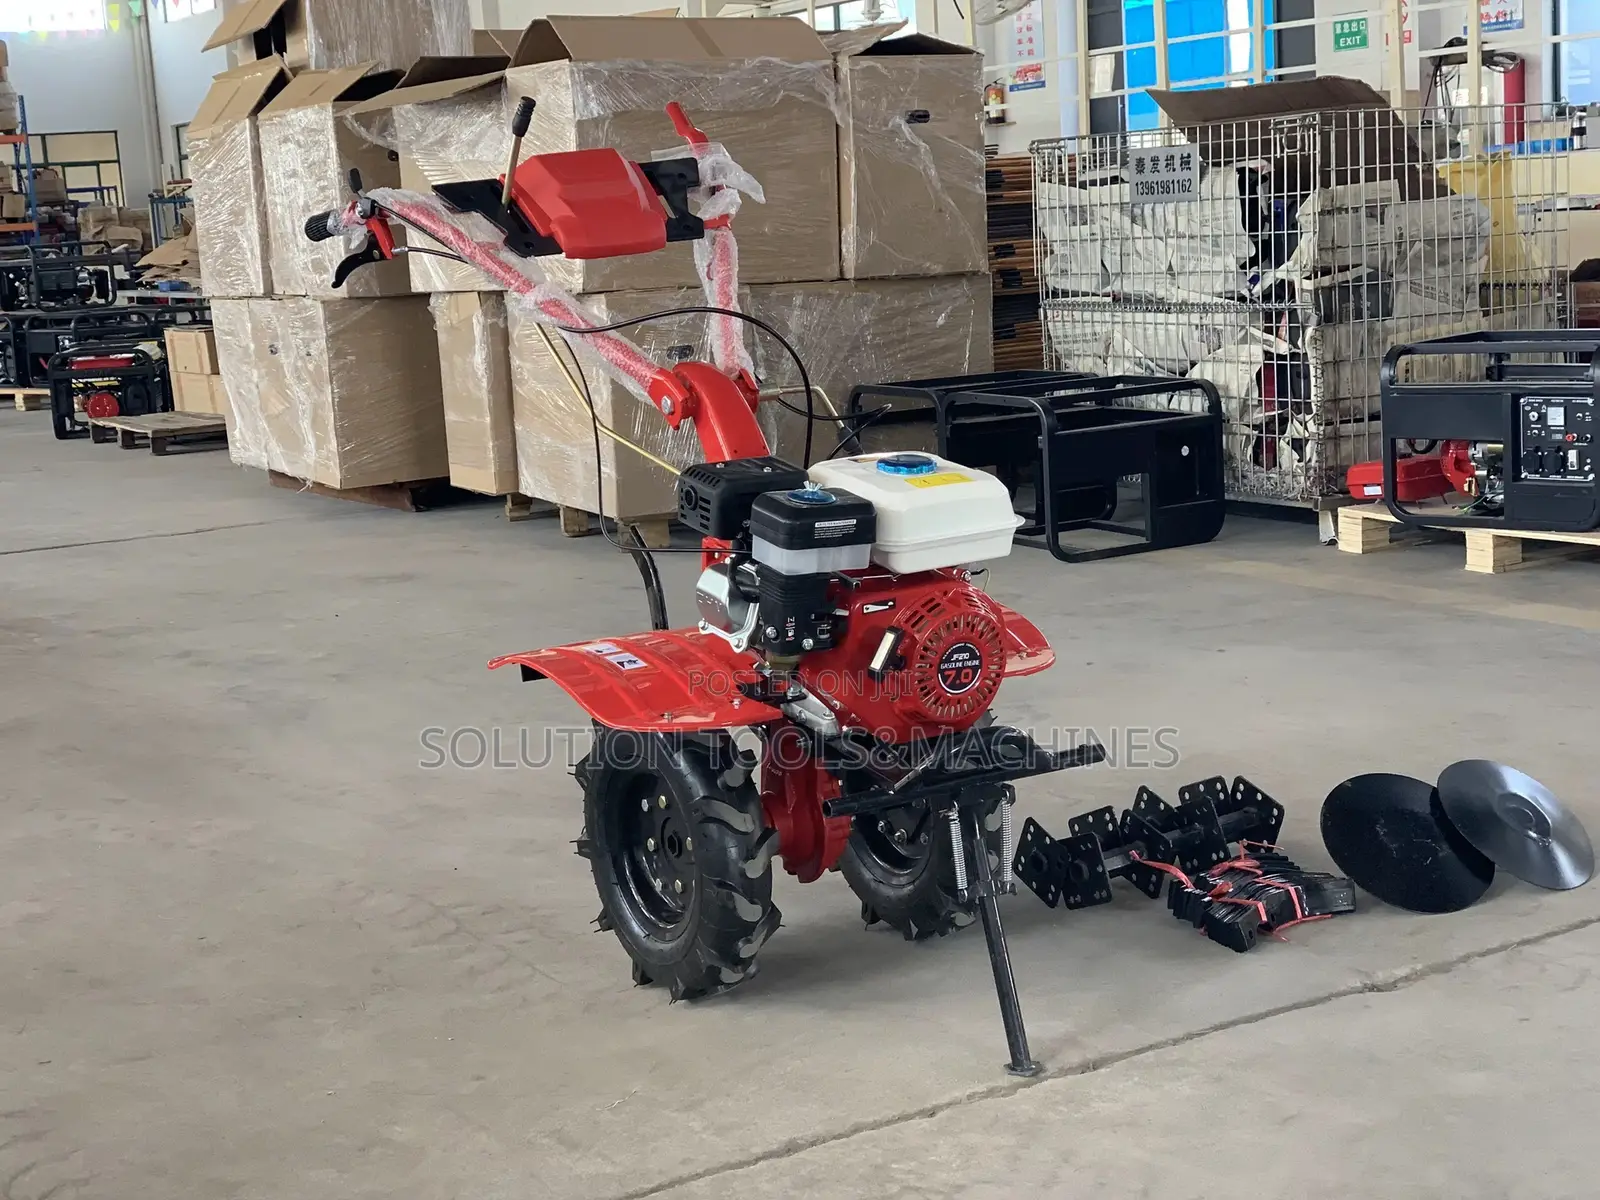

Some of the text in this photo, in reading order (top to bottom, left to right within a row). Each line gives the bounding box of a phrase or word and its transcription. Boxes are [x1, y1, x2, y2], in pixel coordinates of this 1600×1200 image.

[1340, 36, 1361, 46] EXIT
[1135, 178, 1192, 196] 13961981162
[940, 661, 963, 669] GASOLINE
[944, 669, 972, 685] 7.0
